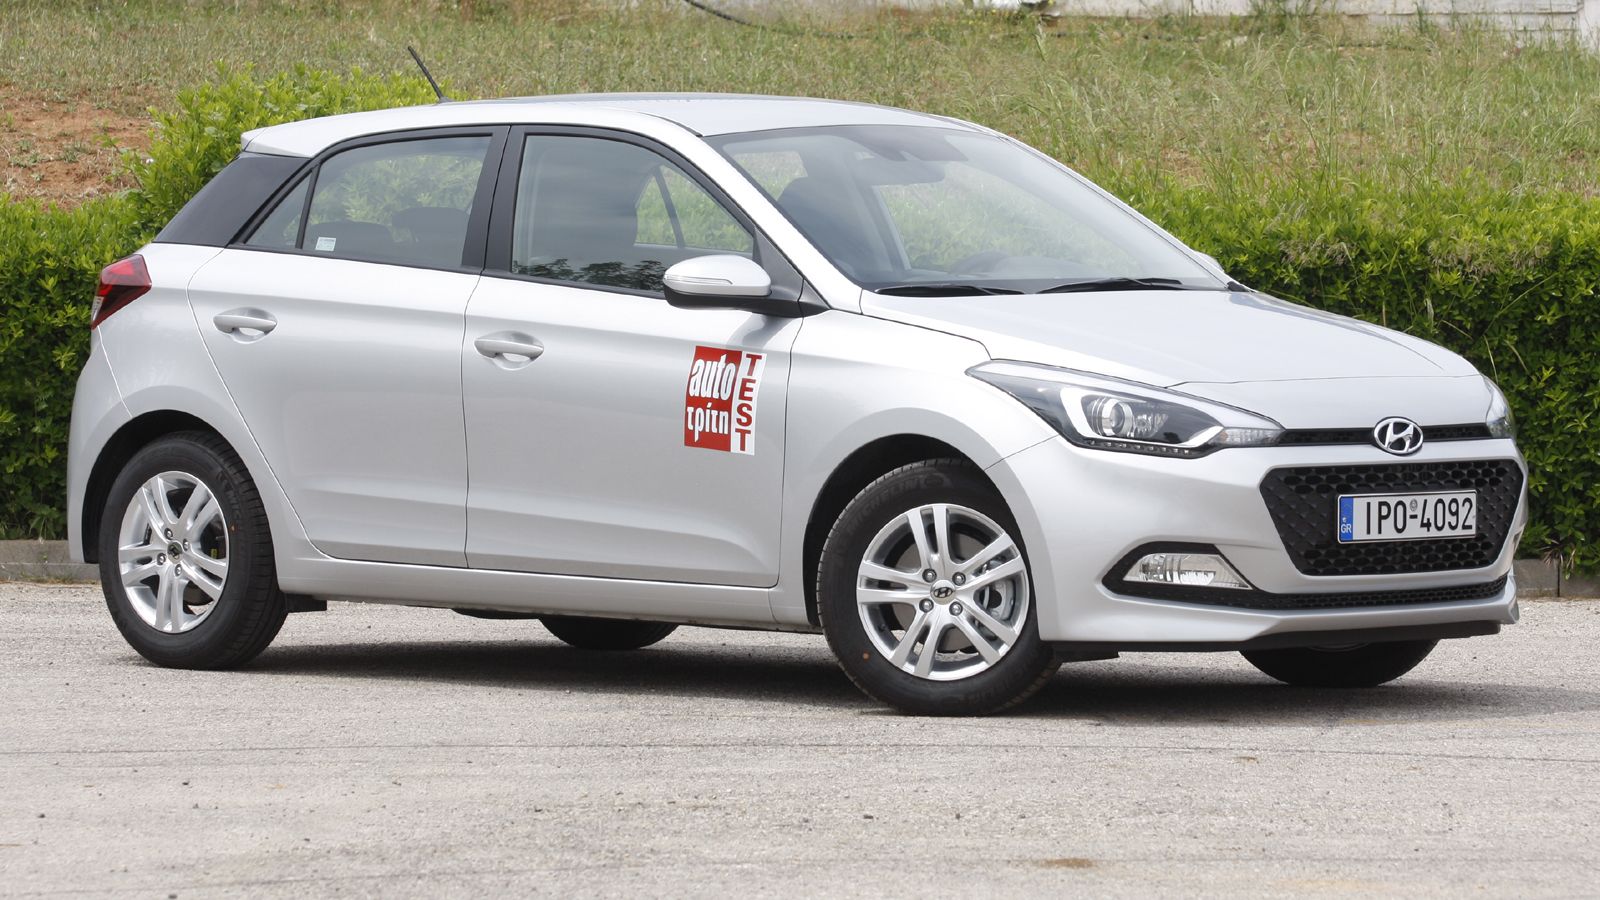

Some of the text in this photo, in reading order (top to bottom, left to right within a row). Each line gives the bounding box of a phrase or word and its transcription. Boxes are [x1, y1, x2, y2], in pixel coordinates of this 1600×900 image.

[689, 354, 736, 400] auto
[735, 353, 762, 452] TEST
[1340, 523, 1352, 534] GR
[1366, 497, 1473, 535] IPO-4092
